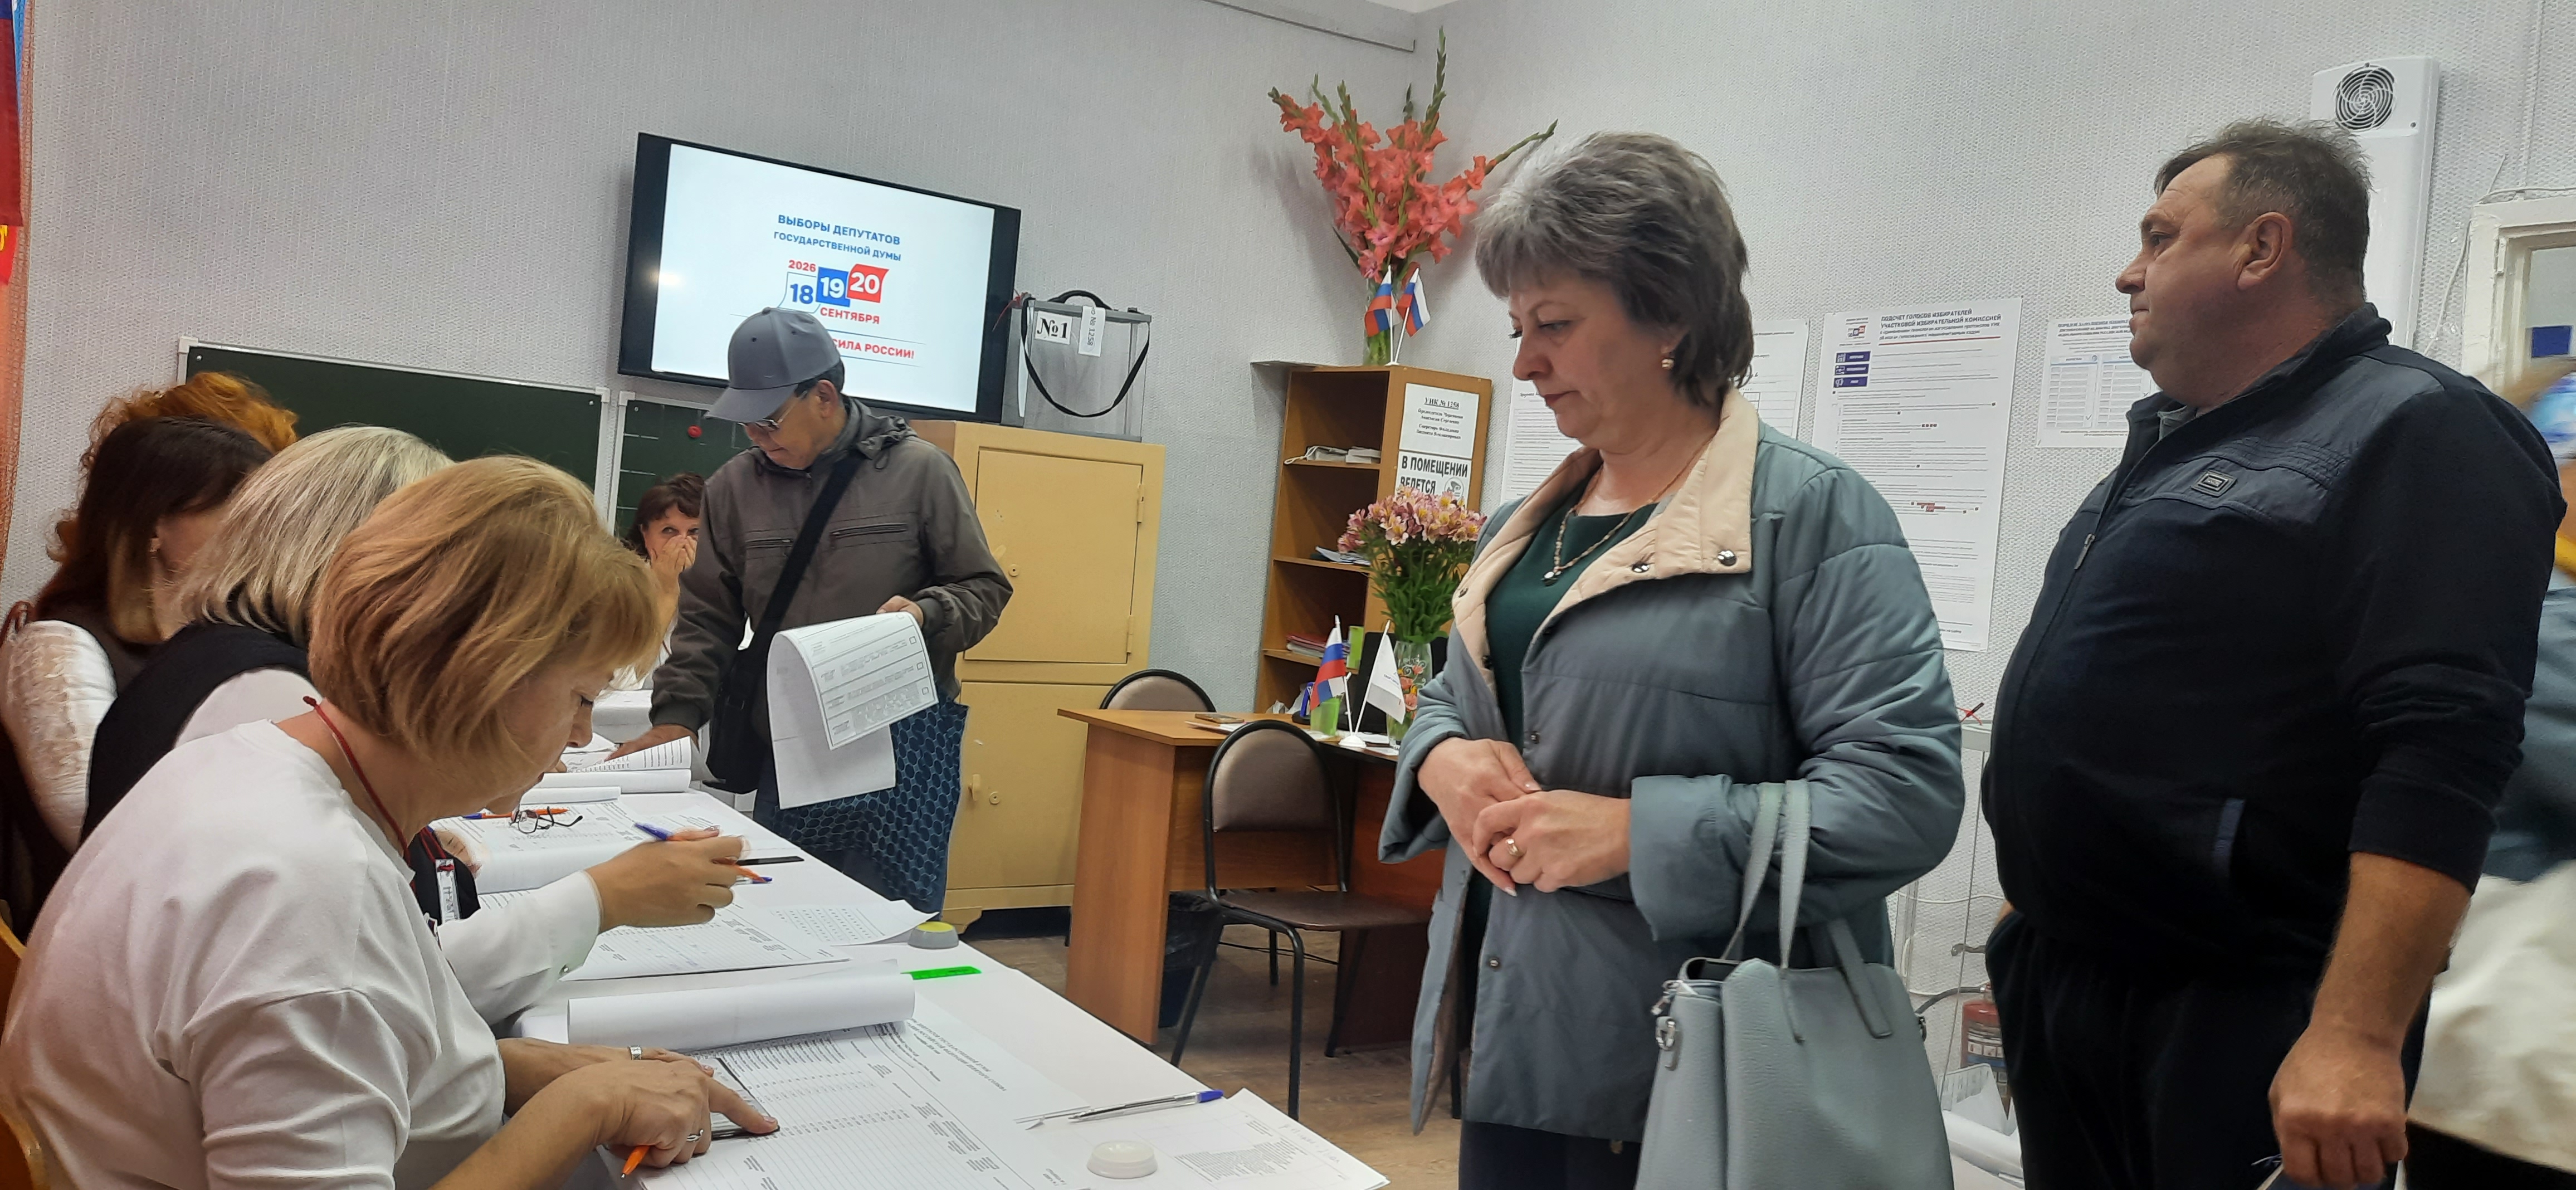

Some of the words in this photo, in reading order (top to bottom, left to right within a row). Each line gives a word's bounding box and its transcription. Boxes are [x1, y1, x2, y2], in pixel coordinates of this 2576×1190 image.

[778, 214, 830, 232] ВЫБОРЫ
[833, 225, 900, 245] ДЕПУТАТОВ
[774, 232, 870, 255] ГОСУДАРСТВЕННОЙ
[872, 250, 901, 261] ДУМЫ
[788, 260, 816, 272] 2026
[790, 284, 813, 304] 18
[820, 277, 845, 299] 19
[850, 272, 880, 294] 20
[820, 308, 880, 324] СЕНТЯБРЯ
[1932, 309, 1972, 318] ИЗБИРАТЕЛЕЙ
[1964, 314, 2001, 323] КОМИССИЕЙ
[1037, 318, 1067, 339] №1
[865, 343, 914, 359] РОССИИ!
[1402, 456, 1408, 469] В
[1410, 457, 1468, 477] ПОМЕЩЕНИИ
